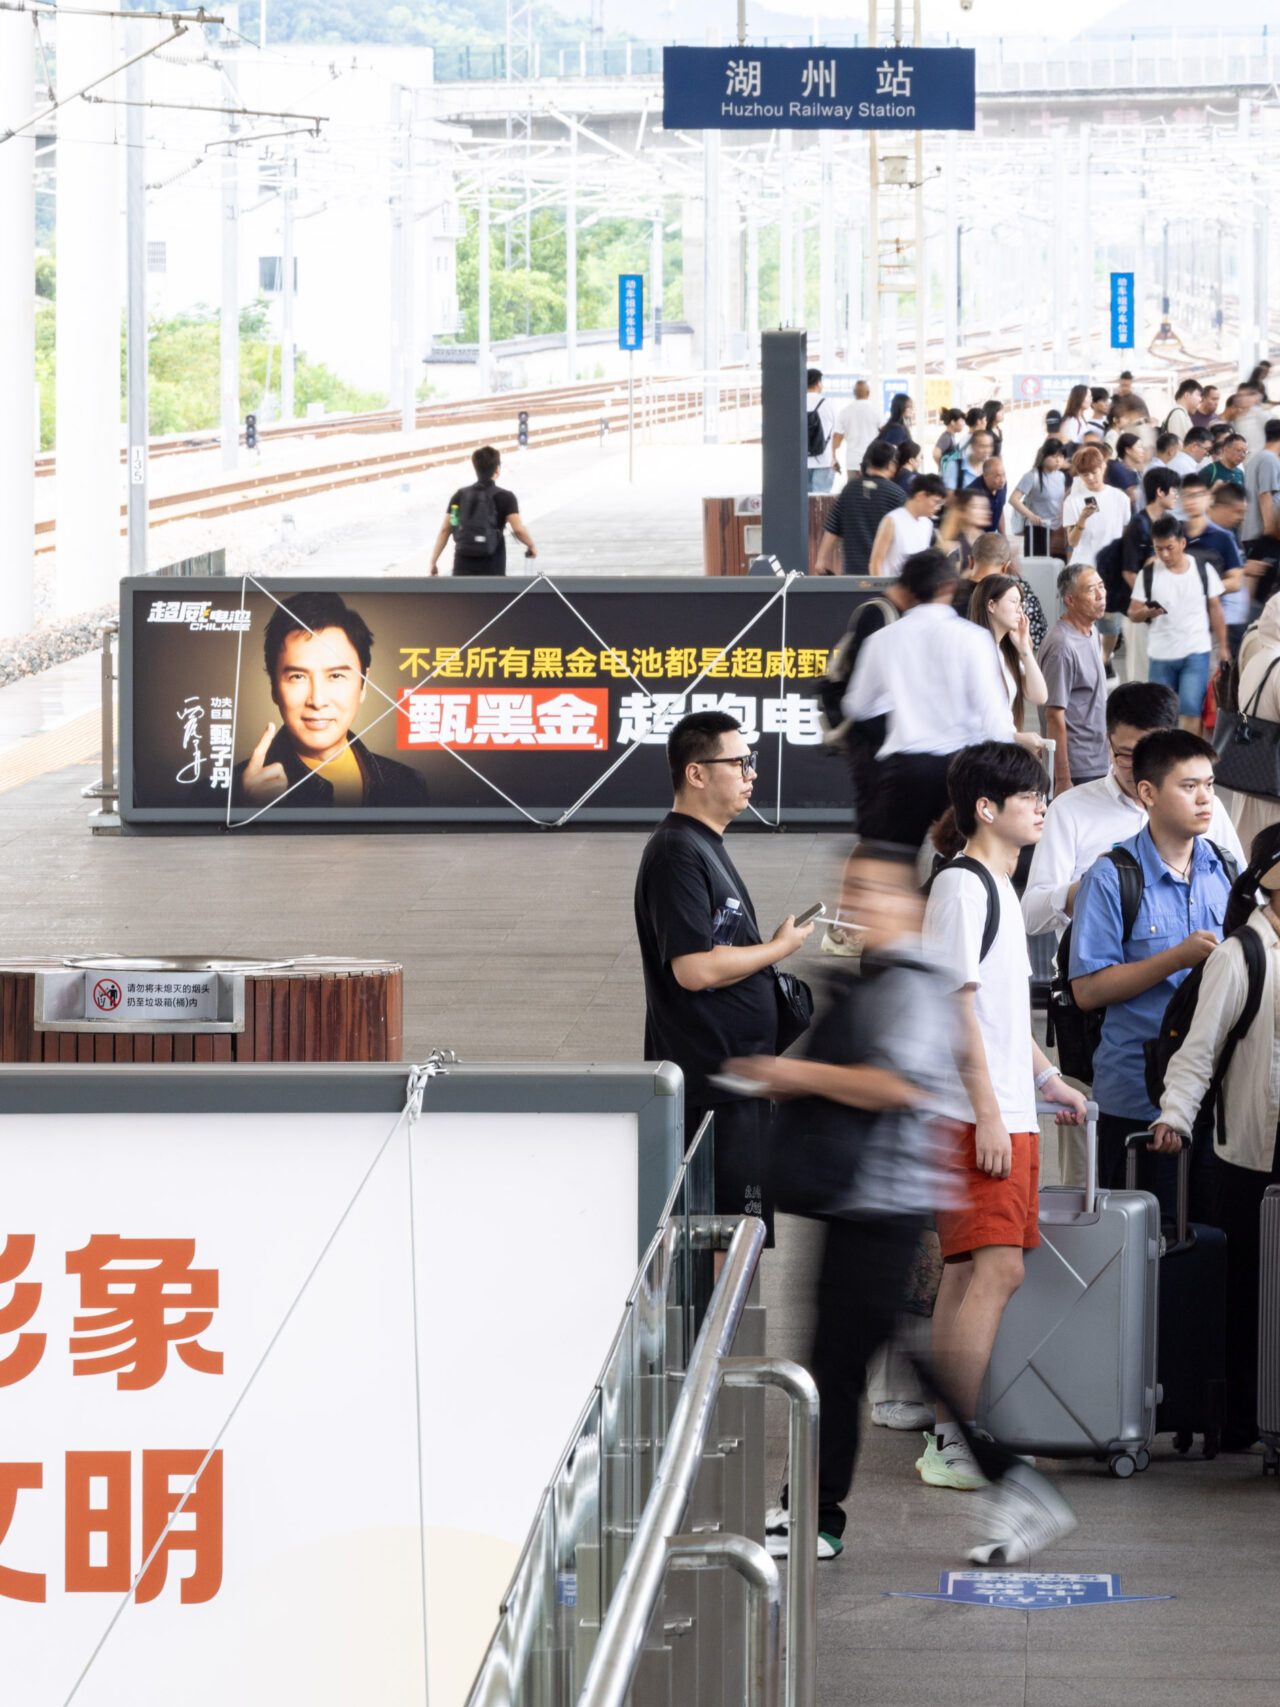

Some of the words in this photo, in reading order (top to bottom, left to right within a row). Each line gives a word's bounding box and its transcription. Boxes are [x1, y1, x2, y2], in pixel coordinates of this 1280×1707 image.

[725, 59, 914, 98] 湖州站
[721, 102, 783, 117] Huzhou
[789, 102, 853, 120] Railway
[858, 102, 915, 117] Station
[190, 623, 250, 631] CHILWEE
[399, 647, 839, 679] 不是所有黑金电池都是超威甄
[210, 724, 232, 788] 甄子丹
[127, 984, 210, 993] 请勿将未熄灭的烟头
[0, 1234, 224, 1391] 象
[0, 1449, 224, 1605] 明
